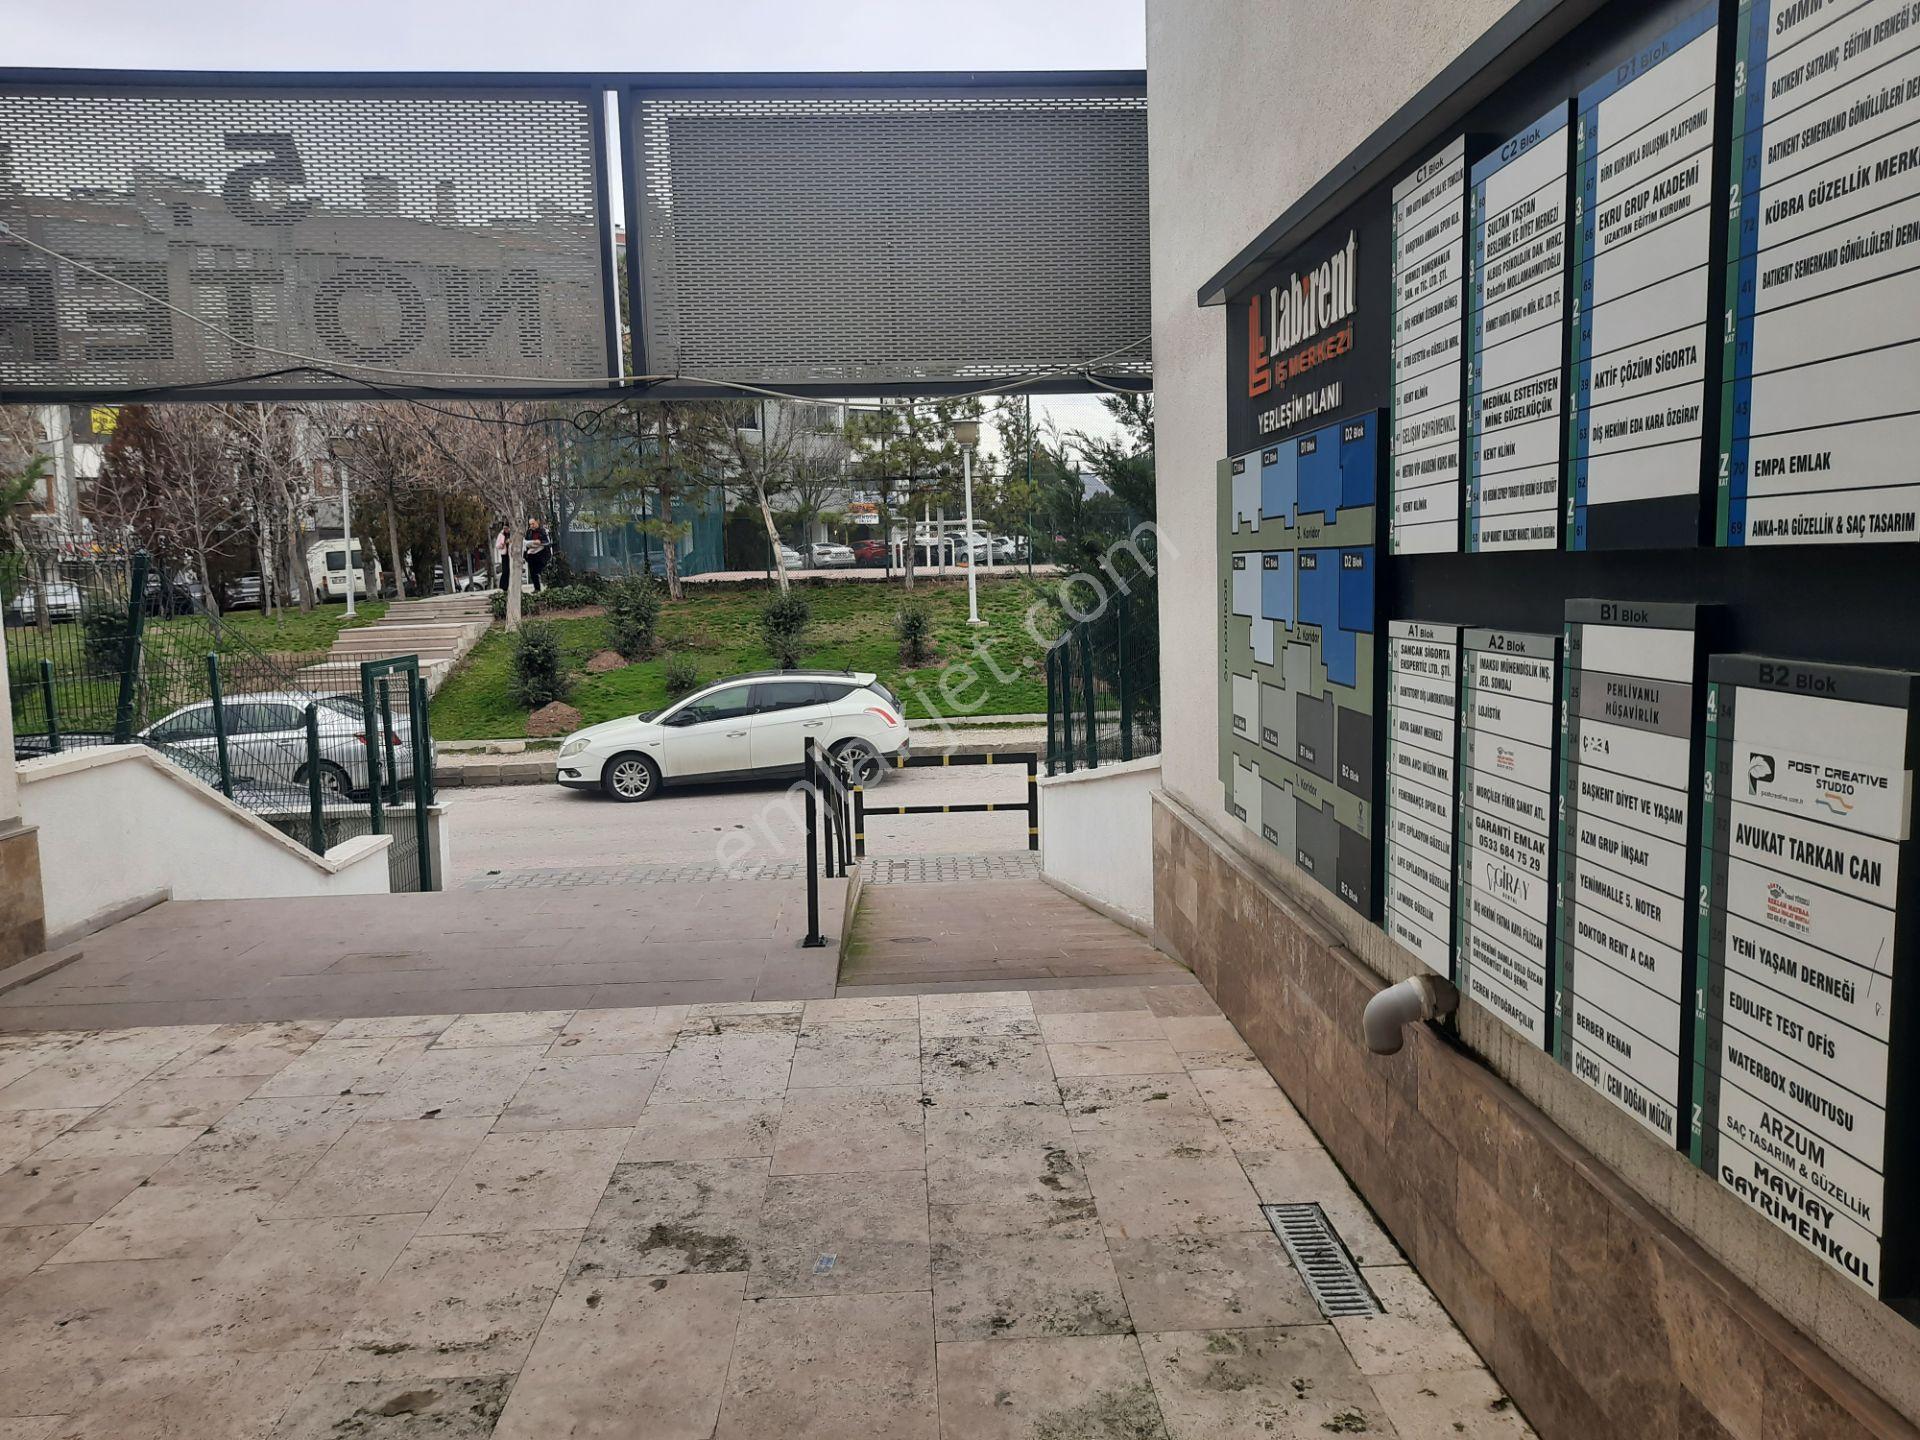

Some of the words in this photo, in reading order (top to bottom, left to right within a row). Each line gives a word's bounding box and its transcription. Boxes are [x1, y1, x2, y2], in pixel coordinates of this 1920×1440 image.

[1772, 66, 1805, 99] BATIKENT
[1806, 46, 1840, 81] SATRANÇ
[1844, 29, 1871, 61] EĞİTİM
[1874, 4, 1910, 45] DERNEĞİ
[1642, 133, 1669, 158] BULUŞMA
[1670, 108, 1708, 144] PLATFORMU
[1768, 133, 1800, 164] BATIKENT
[1801, 111, 1846, 149] SEMERKAND
[1849, 79, 1905, 128] GÖNÜLLÜLERİ
[1501, 141, 1517, 162] C2
[1520, 129, 1541, 150] Blok
[1416, 166, 1427, 183] C1
[1599, 204, 1621, 231] EKRU
[1625, 191, 1649, 217] GRUP
[1653, 160, 1699, 205] AKADEMİ
[1765, 194, 1804, 225] KÜBRA
[1808, 166, 1872, 208] GÜZELLİK
[1875, 147, 1920, 183] MERK
[1487, 212, 1509, 238] SULTAN
[1511, 197, 1535, 224] TAŞTAN
[1604, 222, 1632, 245] UZAKTAN
[1634, 210, 1657, 231] EĞİTİM
[1660, 194, 1691, 218] KURUMU
[1762, 263, 1793, 289] BATIKENT
[1795, 248, 1838, 280] SEMERKAND
[1840, 225, 1894, 265] GÖNÜLLÜLERİ
[1896, 221, 1920, 246] DERN
[1270, 229, 1358, 357] Labirent
[1288, 319, 1354, 378] MERKEZİ
[1594, 363, 1617, 390] AKTİF
[1620, 356, 1652, 388] ÇÖZÜM
[1655, 345, 1697, 374] SİGORTA
[1258, 393, 1303, 435] YERLEŞİM
[1306, 381, 1339, 417] PLANI
[1483, 391, 1512, 411] MEDİKAL
[1514, 376, 1558, 402] ESTETİSYEN
[1485, 411, 1502, 428] MİNE
[1504, 397, 1552, 422] GÜZELKÜÇÜK
[1604, 419, 1628, 439] HEKİMİ
[1630, 417, 1644, 434] EDA
[1645, 413, 1665, 431] KARA
[1667, 405, 1700, 427] ÖZGİRAY
[1754, 457, 1786, 477] EMPA
[1789, 452, 1831, 473] EMLAK
[1752, 518, 1789, 537] ANKA-RA
[1791, 512, 1834, 536] GÜZELLİK
[1836, 518, 1843, 534] &
[1846, 515, 1866, 538] SAÇ
[1869, 512, 1915, 533] TASARIM
[1344, 556, 1351, 567] D2
[1408, 625, 1418, 637] A1
[1420, 629, 1433, 639] Blok
[1601, 604, 1618, 621] B1
[1622, 609, 1648, 623] Blok
[1401, 644, 1423, 657] SANCAK
[1425, 645, 1450, 661] SİGORTA
[1401, 659, 1427, 672] EKSPERTİZ
[1488, 634, 1504, 650] A2
[1507, 640, 1525, 653] Blok
[1607, 682, 1659, 704] PEHLİVANLI
[1759, 663, 1789, 688] B2
[1796, 673, 1836, 693] Blok
[1342, 764, 1349, 777] B2
[1788, 760, 1819, 775] POST
[1825, 767, 1888, 789] CREATIVE
[1816, 778, 1854, 795] STUDIO
[1582, 781, 1614, 805] BAŞKENT
[1616, 790, 1638, 811] DİYET
[1641, 800, 1651, 815] VE
[1654, 802, 1683, 826] YAŞAM
[1476, 816, 1511, 840] GARANTİ
[1514, 830, 1545, 855] EMLAK
[1479, 834, 1498, 853] 0533
[1500, 844, 1514, 860] 684
[1517, 851, 1527, 865] 75
[1530, 857, 1540, 872] 29
[1581, 828, 1597, 847] AZM
[1598, 835, 1619, 856] GRUP
[1621, 840, 1649, 868] İNŞAAT
[1736, 822, 1785, 856] AVUKAT
[1789, 838, 1844, 876] TARKAN
[1849, 855, 1881, 887] CAN
[1580, 872, 1625, 906] YENİMHALLE
[1626, 893, 1633, 910] 5.
[1635, 901, 1662, 923] NOTER
[1578, 920, 1607, 947] DOKTOR
[1609, 935, 1628, 957] RENT
[1631, 948, 1636, 962] A
[1638, 951, 1655, 973] CAR
[1473, 979, 1489, 1000] CEREN
[1732, 935, 1756, 960] YENİ
[1759, 947, 1797, 979] YAŞAM
[1801, 965, 1855, 1005] DERNEĞİ
[1576, 1012, 1604, 1042] BERBER
[1606, 1032, 1632, 1060] KENAN
[1729, 991, 1773, 1027] EDULIFE
[1776, 1014, 1804, 1043] TEST
[1807, 1030, 1836, 1059] OFİS
[1576, 1051, 1600, 1086] ÇİÇEKÇİ
[1607, 1073, 1622, 1100] CEM
[1623, 1088, 1647, 1122] DOĞAN
[1649, 1102, 1672, 1137] MÜZİK
[1728, 1045, 1785, 1093] WATERBOX
[1789, 1078, 1854, 1132] SUKUTUSU
[1760, 1112, 1825, 1168] ARZUM
[1727, 1115, 1746, 1140] SAÇ
[1749, 1128, 1795, 1171] TASARIM
[1799, 1164, 1808, 1180] &
[1811, 1172, 1871, 1221] GÜZELLİK
[1754, 1161, 1835, 1229] MAVİAY
[1721, 1164, 1874, 1287] GAYRİMENKUL
